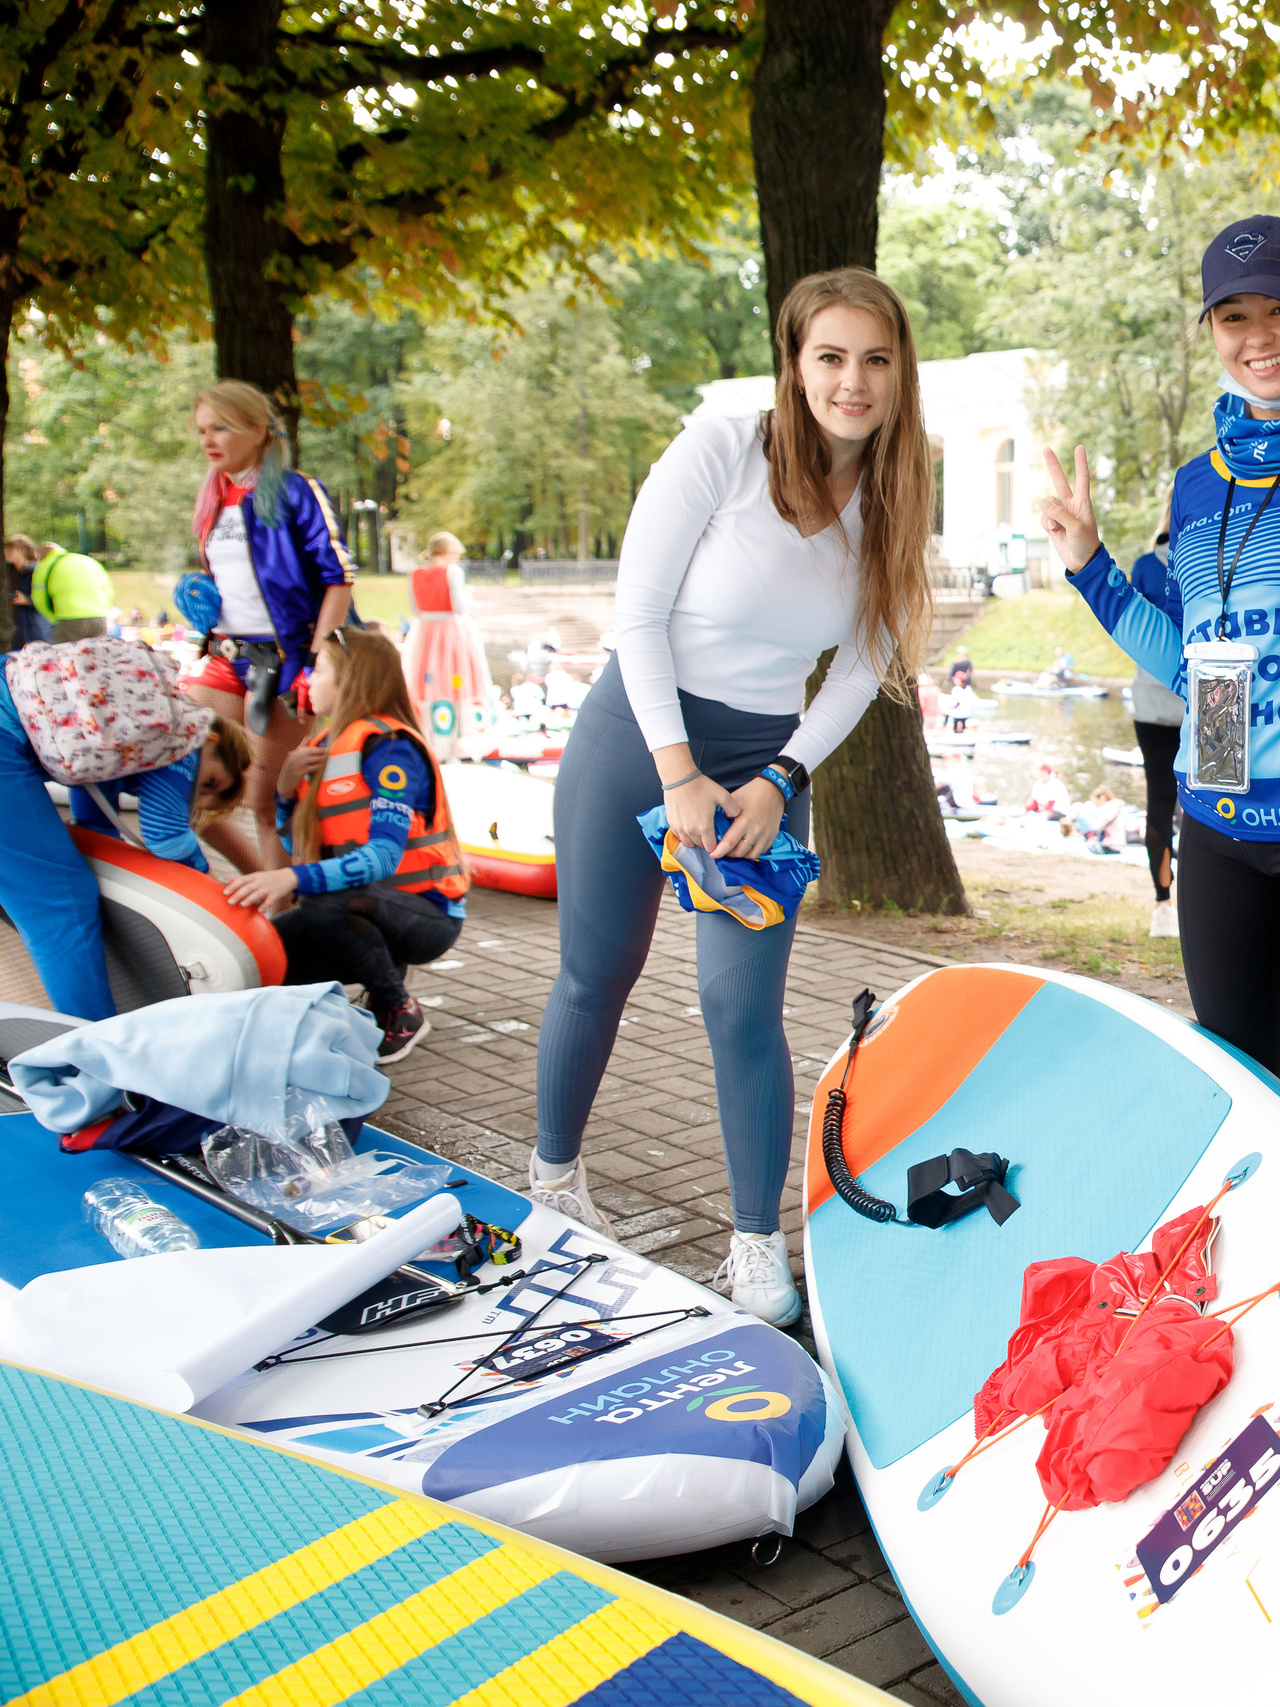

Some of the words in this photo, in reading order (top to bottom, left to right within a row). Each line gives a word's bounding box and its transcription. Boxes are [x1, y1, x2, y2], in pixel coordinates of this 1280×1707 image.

[492, 1329, 592, 1371] 0637
[547, 1349, 737, 1425] онлайн
[594, 1360, 758, 1425] лента
[1200, 1460, 1232, 1497] SUP
